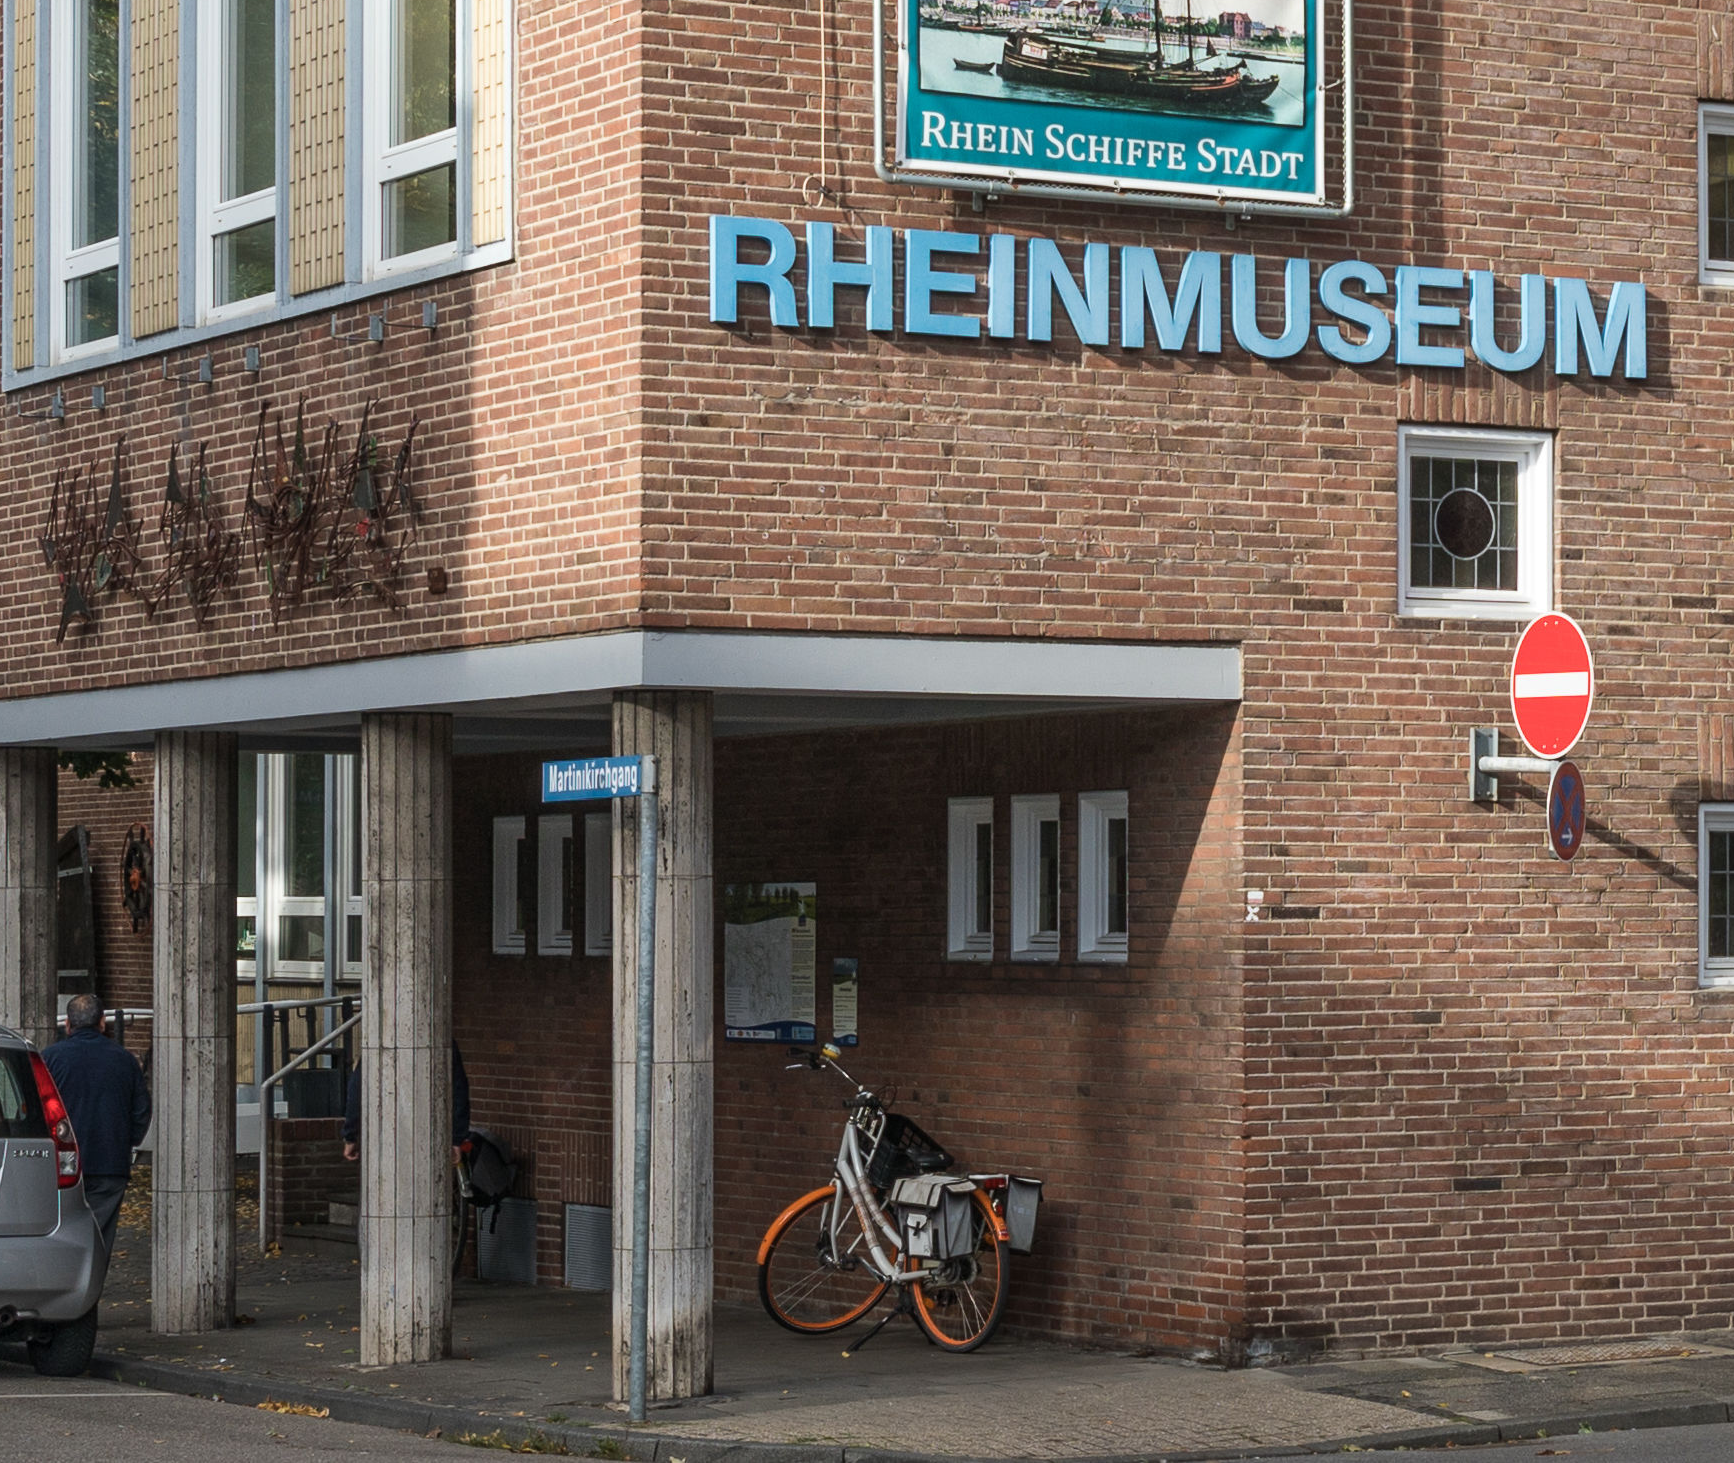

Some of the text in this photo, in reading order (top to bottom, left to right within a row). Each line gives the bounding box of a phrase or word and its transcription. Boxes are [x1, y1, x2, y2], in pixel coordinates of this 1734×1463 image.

[920, 110, 1304, 179] RHEIN SCHIFFE STADT
[709, 215, 1648, 380] RHEINMUSEUM
